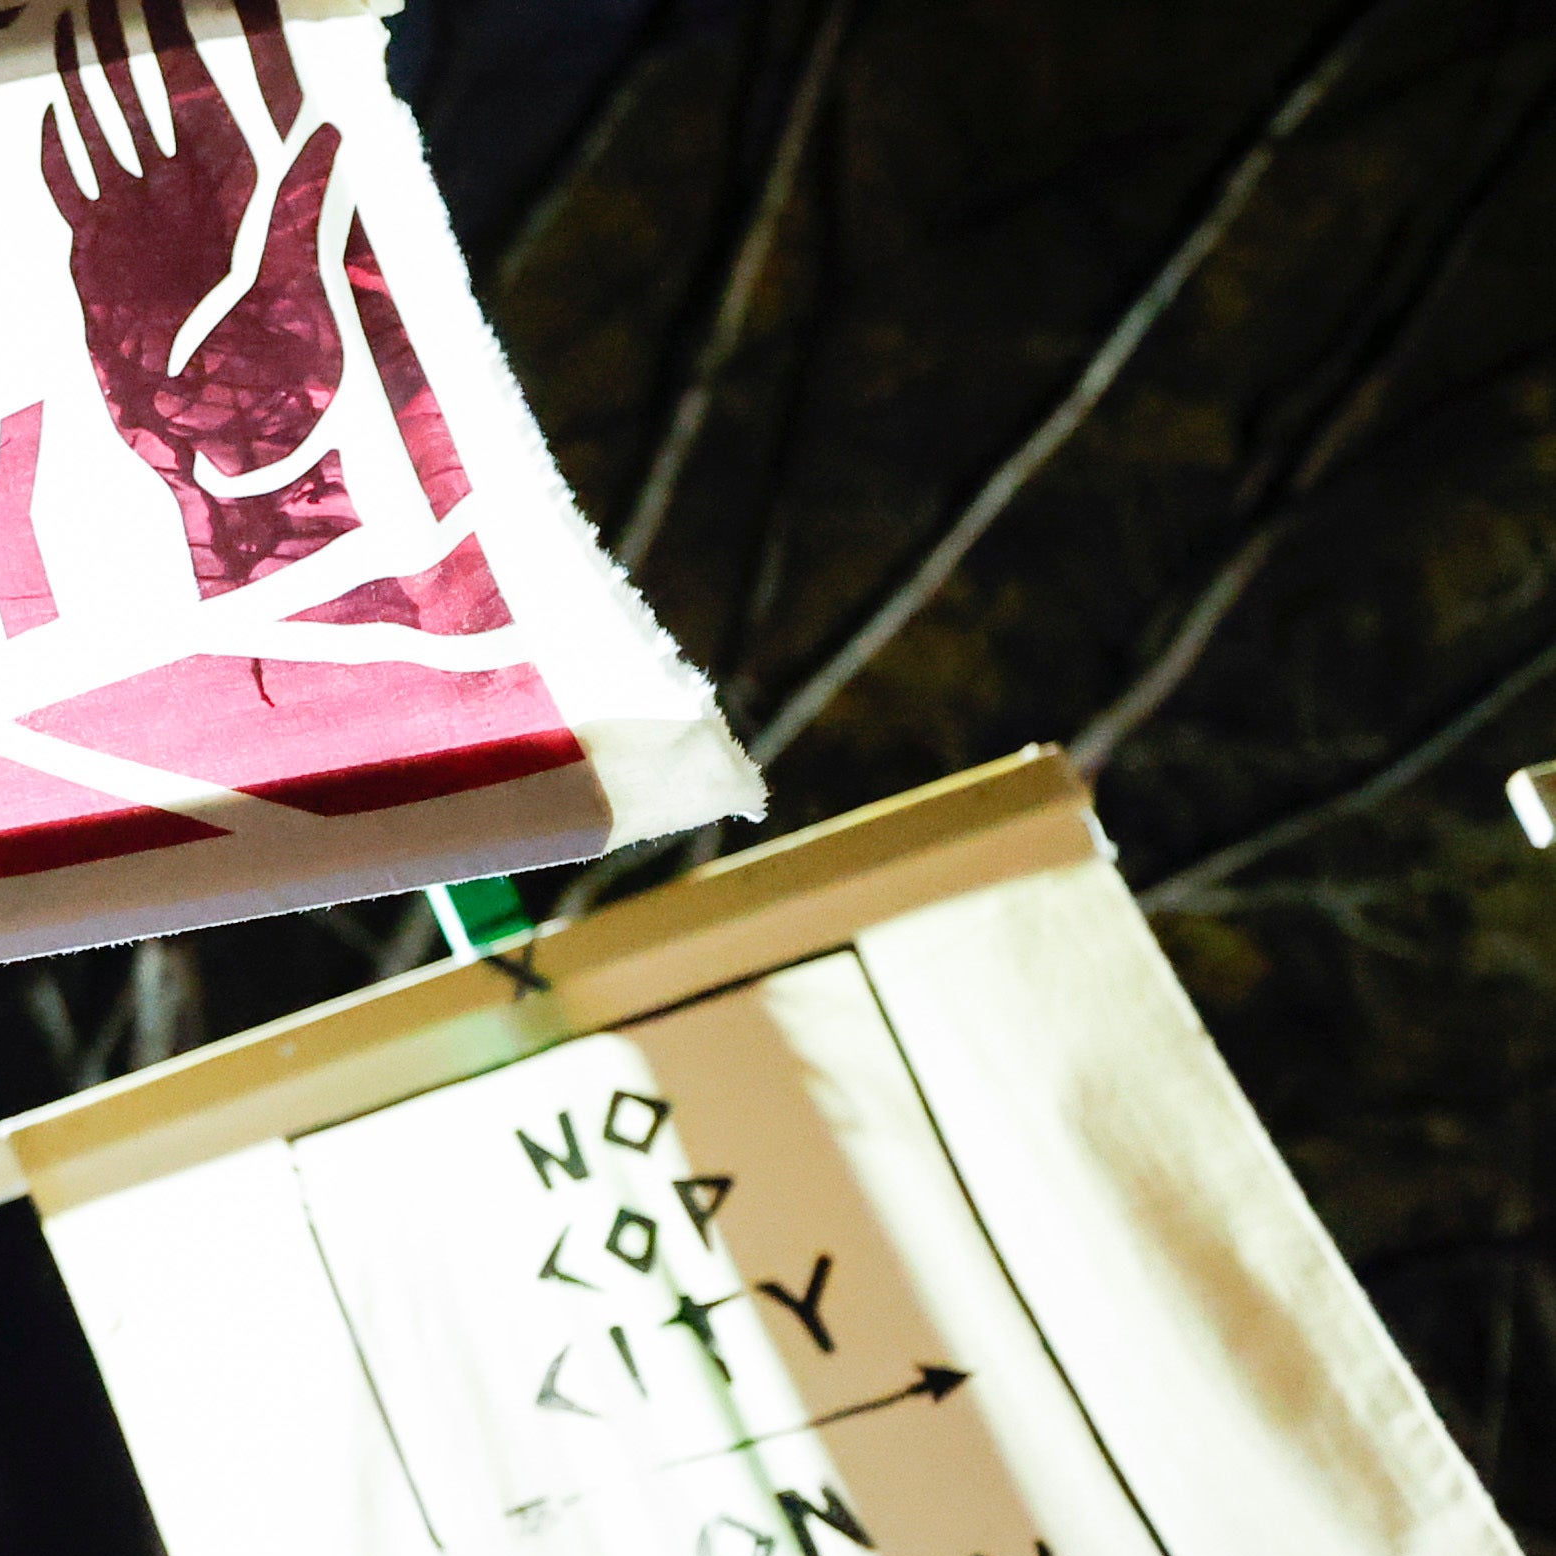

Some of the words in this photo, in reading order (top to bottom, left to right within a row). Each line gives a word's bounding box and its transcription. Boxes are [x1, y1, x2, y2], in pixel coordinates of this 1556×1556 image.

[515, 1089, 672, 1190] NO
[537, 1175, 734, 1291] COP
[535, 1254, 834, 1418] CITY
